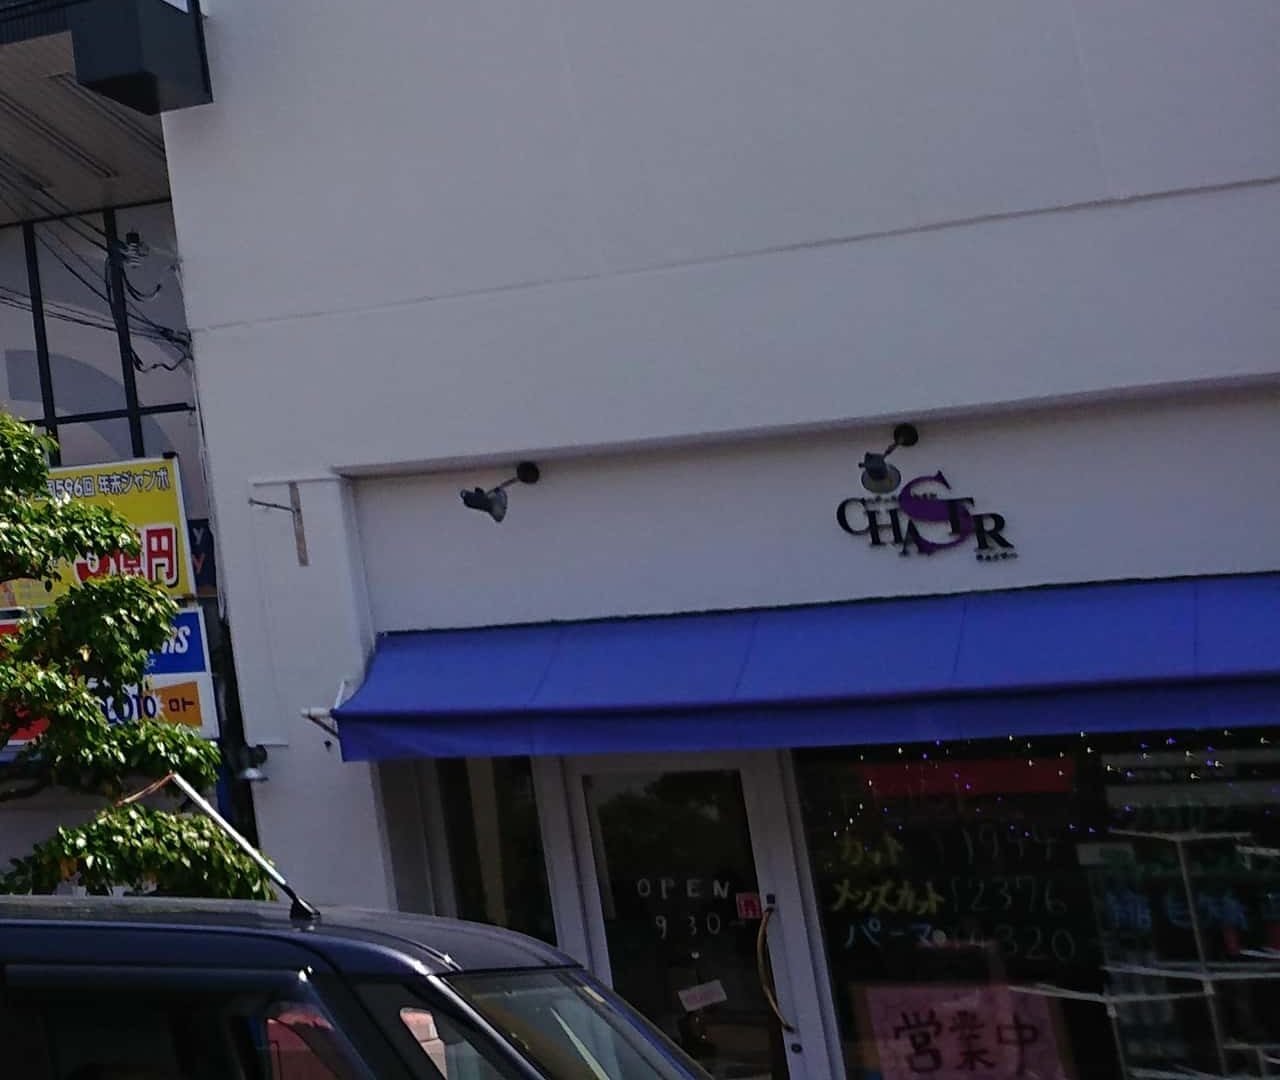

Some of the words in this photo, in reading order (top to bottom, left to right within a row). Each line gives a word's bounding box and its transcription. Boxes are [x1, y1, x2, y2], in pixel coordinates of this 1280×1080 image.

[636, 876, 730, 900] OPEN
[893, 1007, 1040, 1076] 営業中
